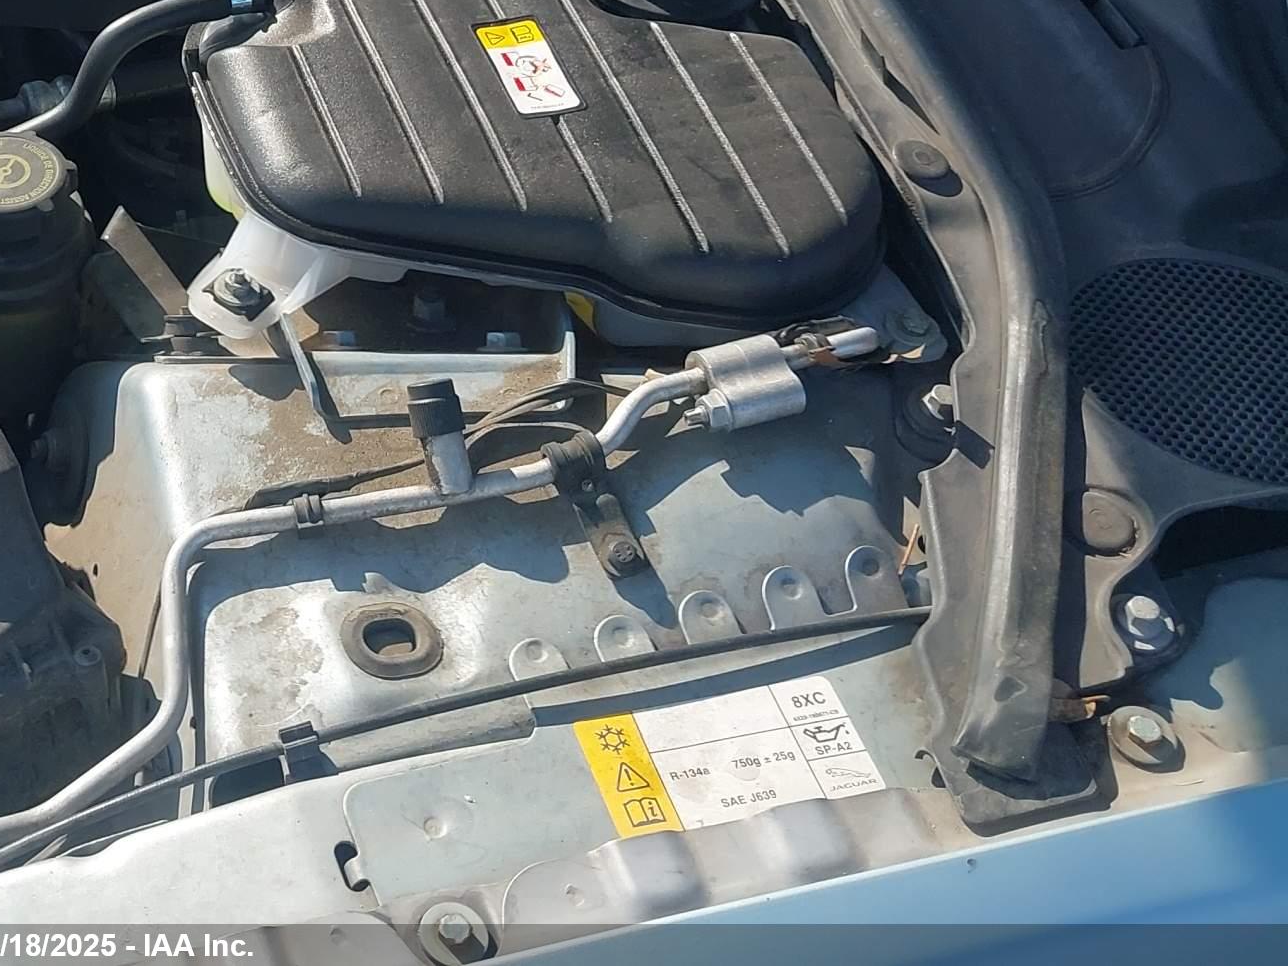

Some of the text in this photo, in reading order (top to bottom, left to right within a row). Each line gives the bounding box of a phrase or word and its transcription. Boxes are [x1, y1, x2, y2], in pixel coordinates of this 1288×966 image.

[791, 691, 826, 708] 8XC
[814, 741, 853, 755] SP-A2
[731, 756, 762, 770] 750g
[772, 751, 796, 762] 25g
[669, 767, 711, 781] R-134a
[829, 778, 879, 792] JAGUAR
[720, 789, 777, 809] SAE J639
